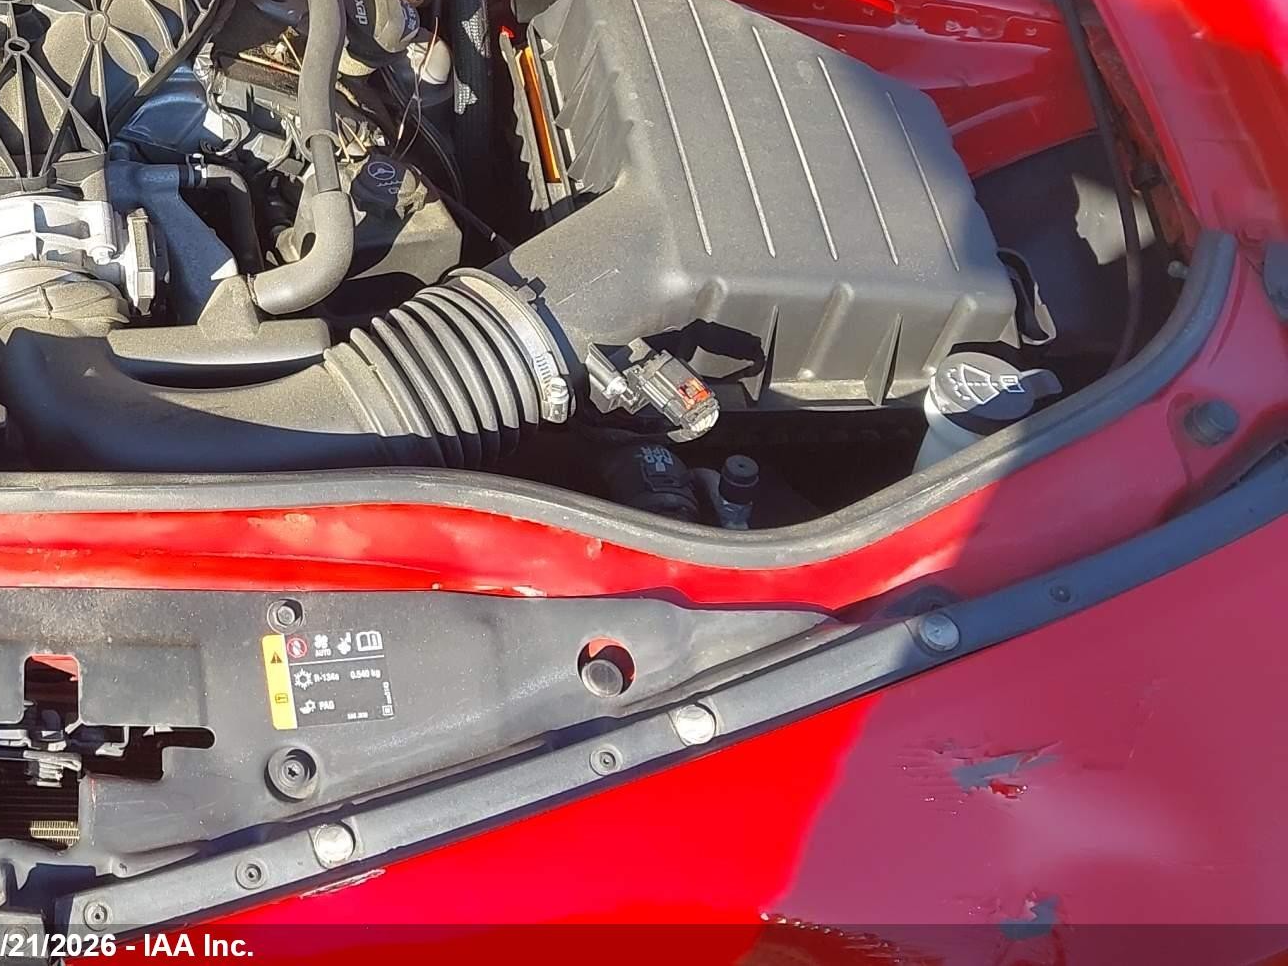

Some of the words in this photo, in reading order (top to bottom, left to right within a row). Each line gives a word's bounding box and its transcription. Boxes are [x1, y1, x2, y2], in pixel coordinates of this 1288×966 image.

[315, 648, 332, 657] AUTO
[313, 672, 340, 683] R-134a
[370, 668, 381, 679] kg
[318, 700, 335, 711] PAG
